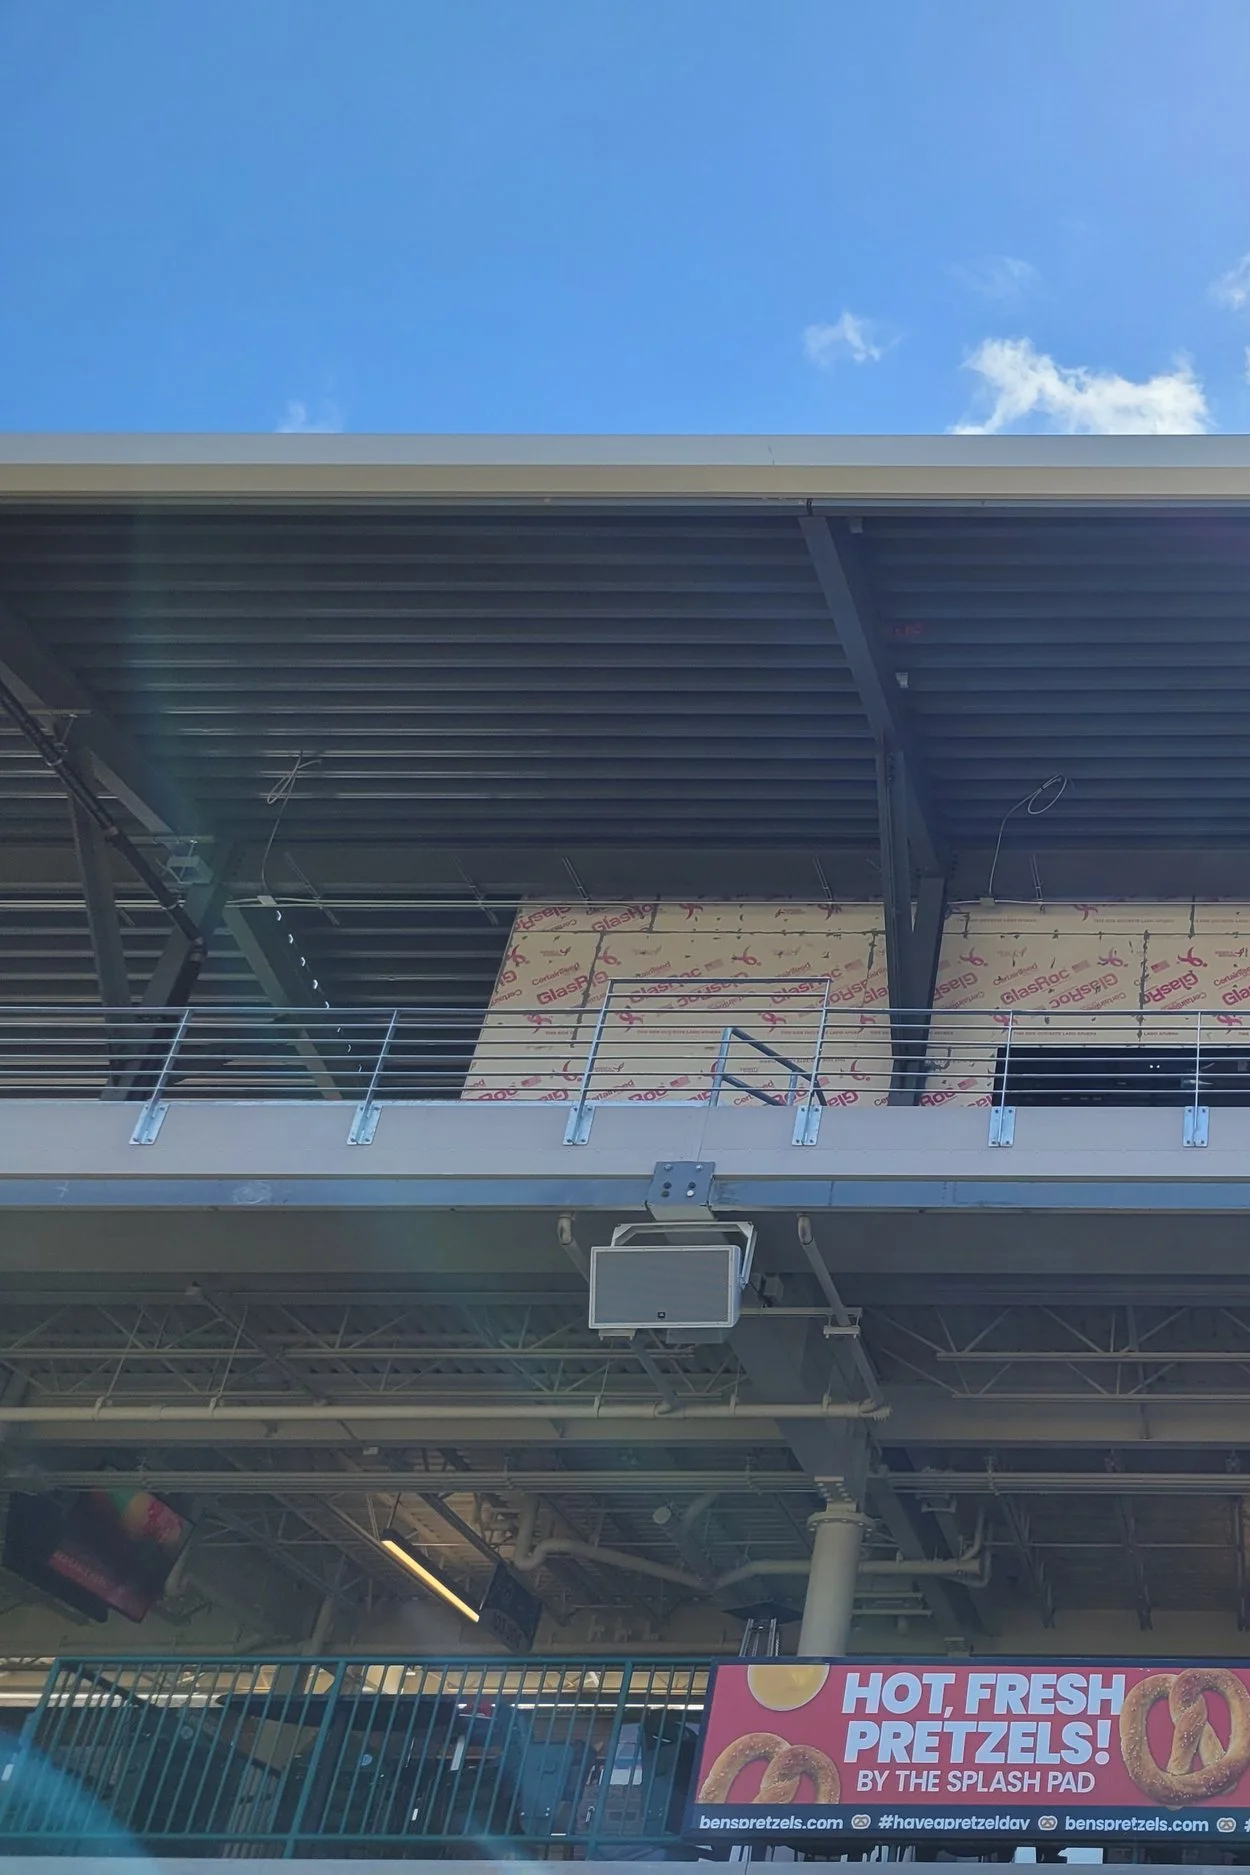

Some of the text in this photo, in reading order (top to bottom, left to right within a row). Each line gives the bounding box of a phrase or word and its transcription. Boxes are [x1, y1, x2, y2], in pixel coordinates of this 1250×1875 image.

[1000, 969, 1070, 1005] GlasRoc
[1049, 973, 1118, 1009] GlasRoc
[841, 1672, 1126, 1719] HOT, FRESH
[843, 1719, 1112, 1765] PRETZELS!
[856, 1770, 1096, 1794] BY THE SPLASH PAD
[699, 1815, 843, 1830] benspretzels.com
[1064, 1816, 1209, 1832] benspretzels.com
